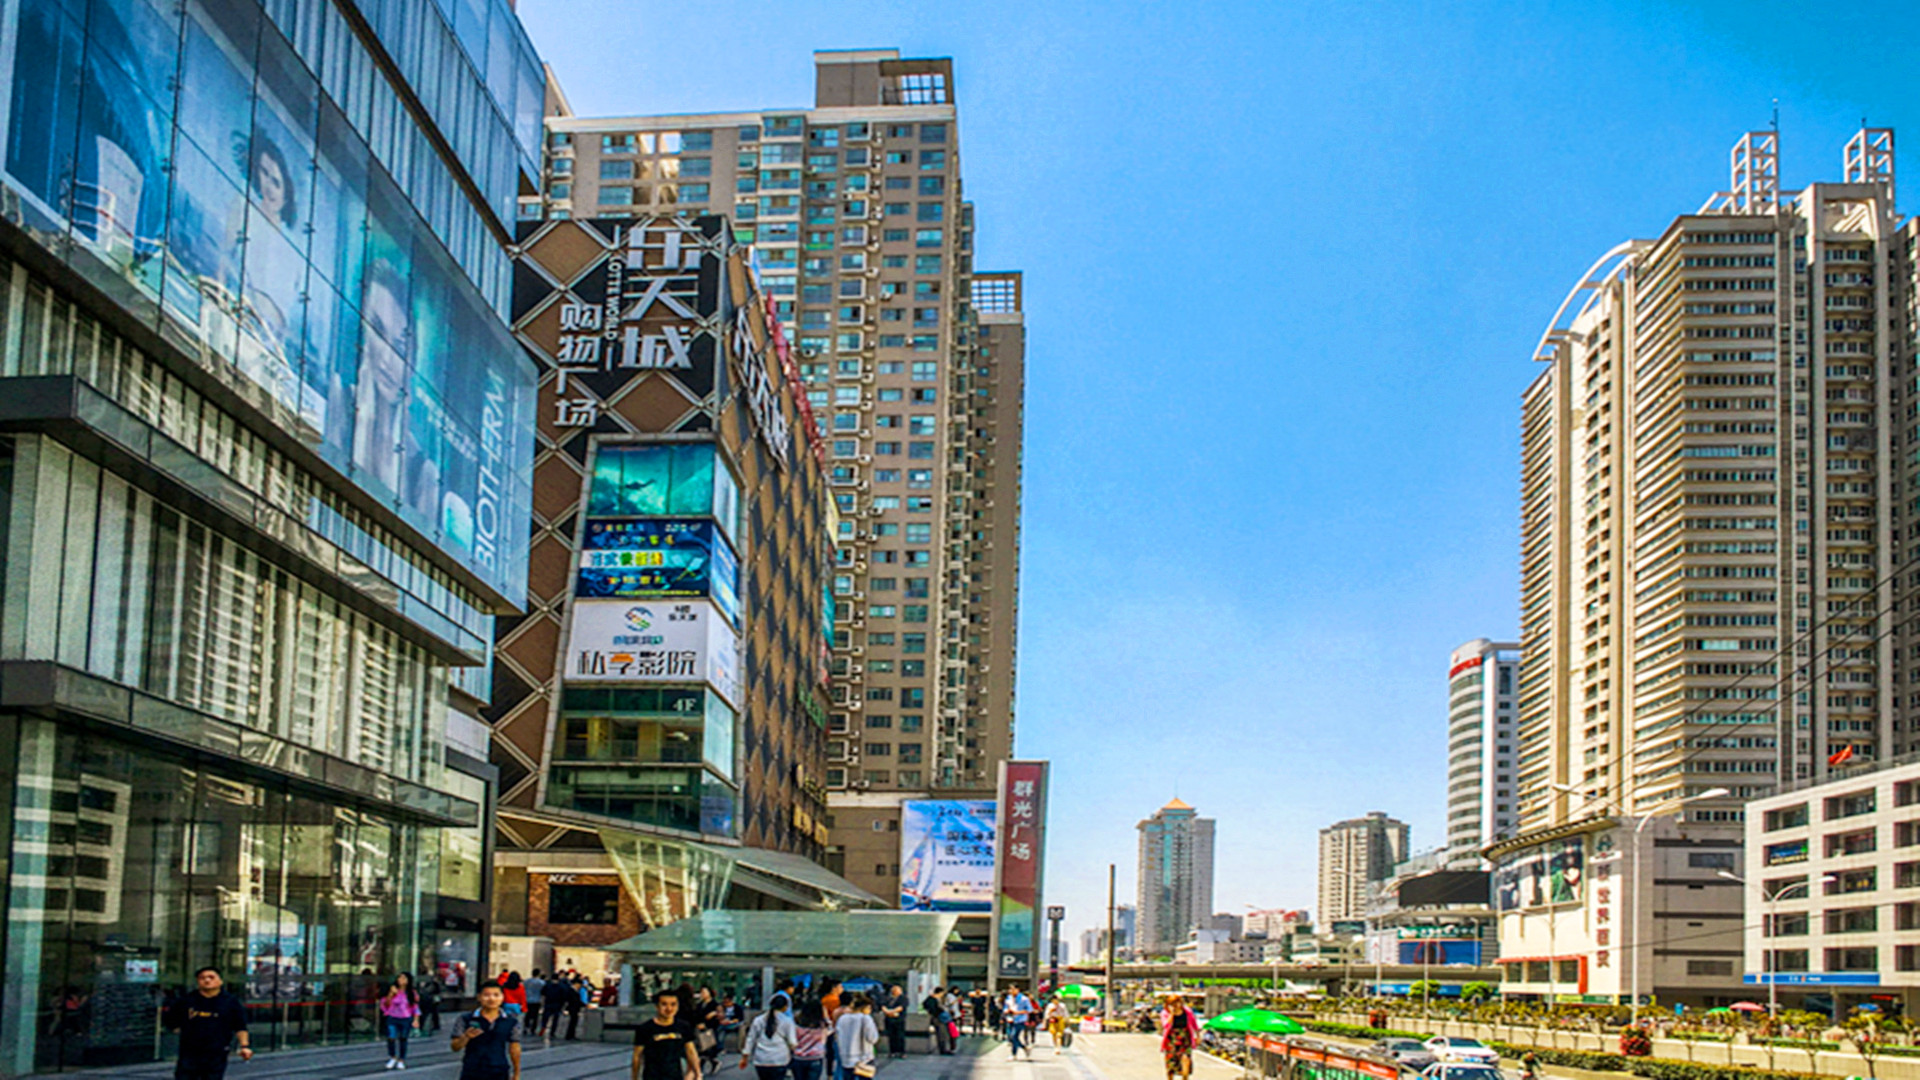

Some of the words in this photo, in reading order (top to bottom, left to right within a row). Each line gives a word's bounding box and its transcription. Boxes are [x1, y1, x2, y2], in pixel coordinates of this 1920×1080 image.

[603, 296, 620, 341] WORLD
[552, 302, 602, 428] 购物广场
[474, 367, 506, 572] BIOTHERM
[577, 651, 697, 675] 私享影院
[673, 698, 697, 711] 4F
[1010, 780, 1034, 861] 群光广场
[548, 874, 577, 883] KFC
[1002, 955, 1015, 969] P
